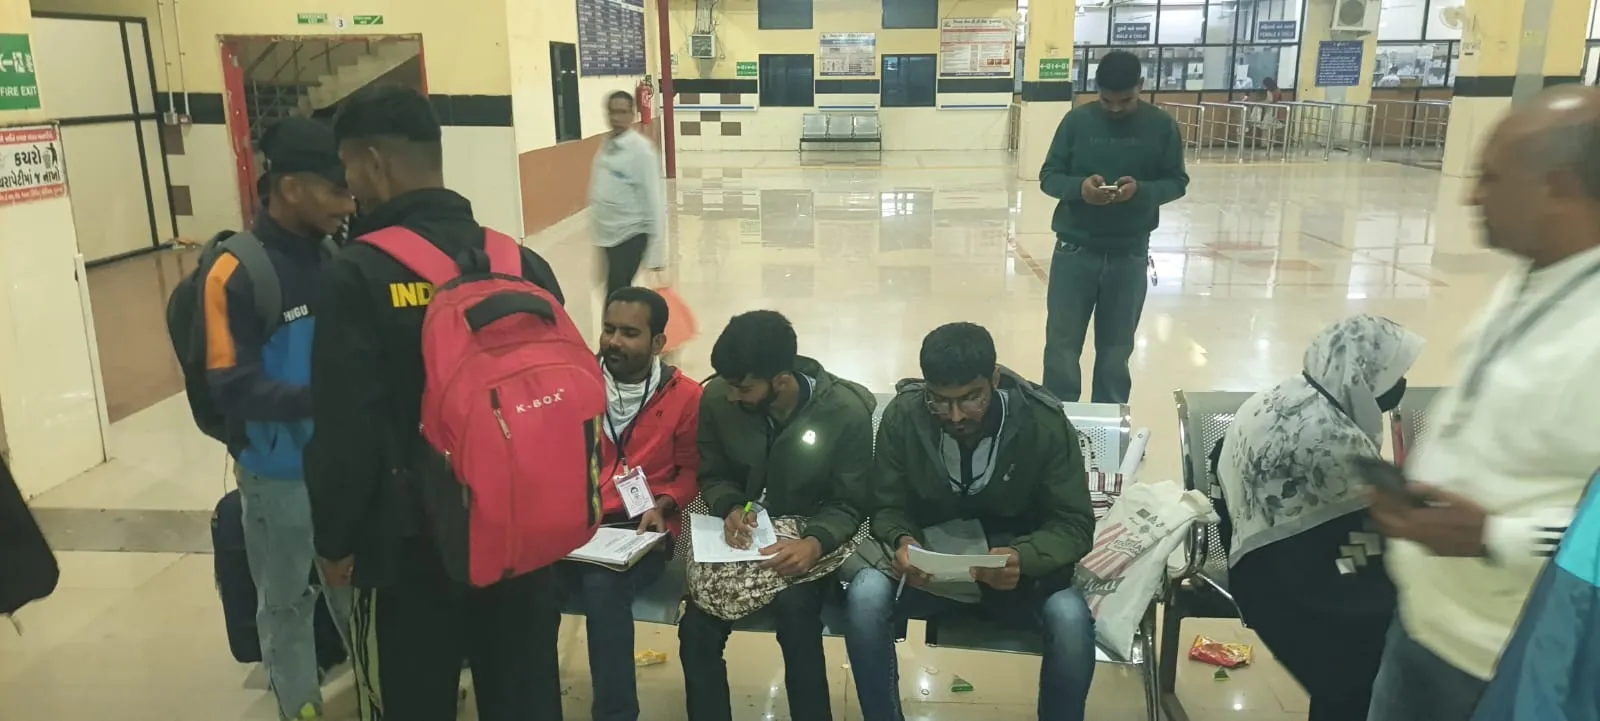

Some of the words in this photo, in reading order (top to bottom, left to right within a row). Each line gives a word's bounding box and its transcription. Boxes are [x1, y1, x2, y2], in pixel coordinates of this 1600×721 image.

[0, 86, 19, 97] FIRE
[20, 85, 37, 96] EXIT
[14, 144, 42, 167] કચરો
[389, 281, 435, 307] IND
